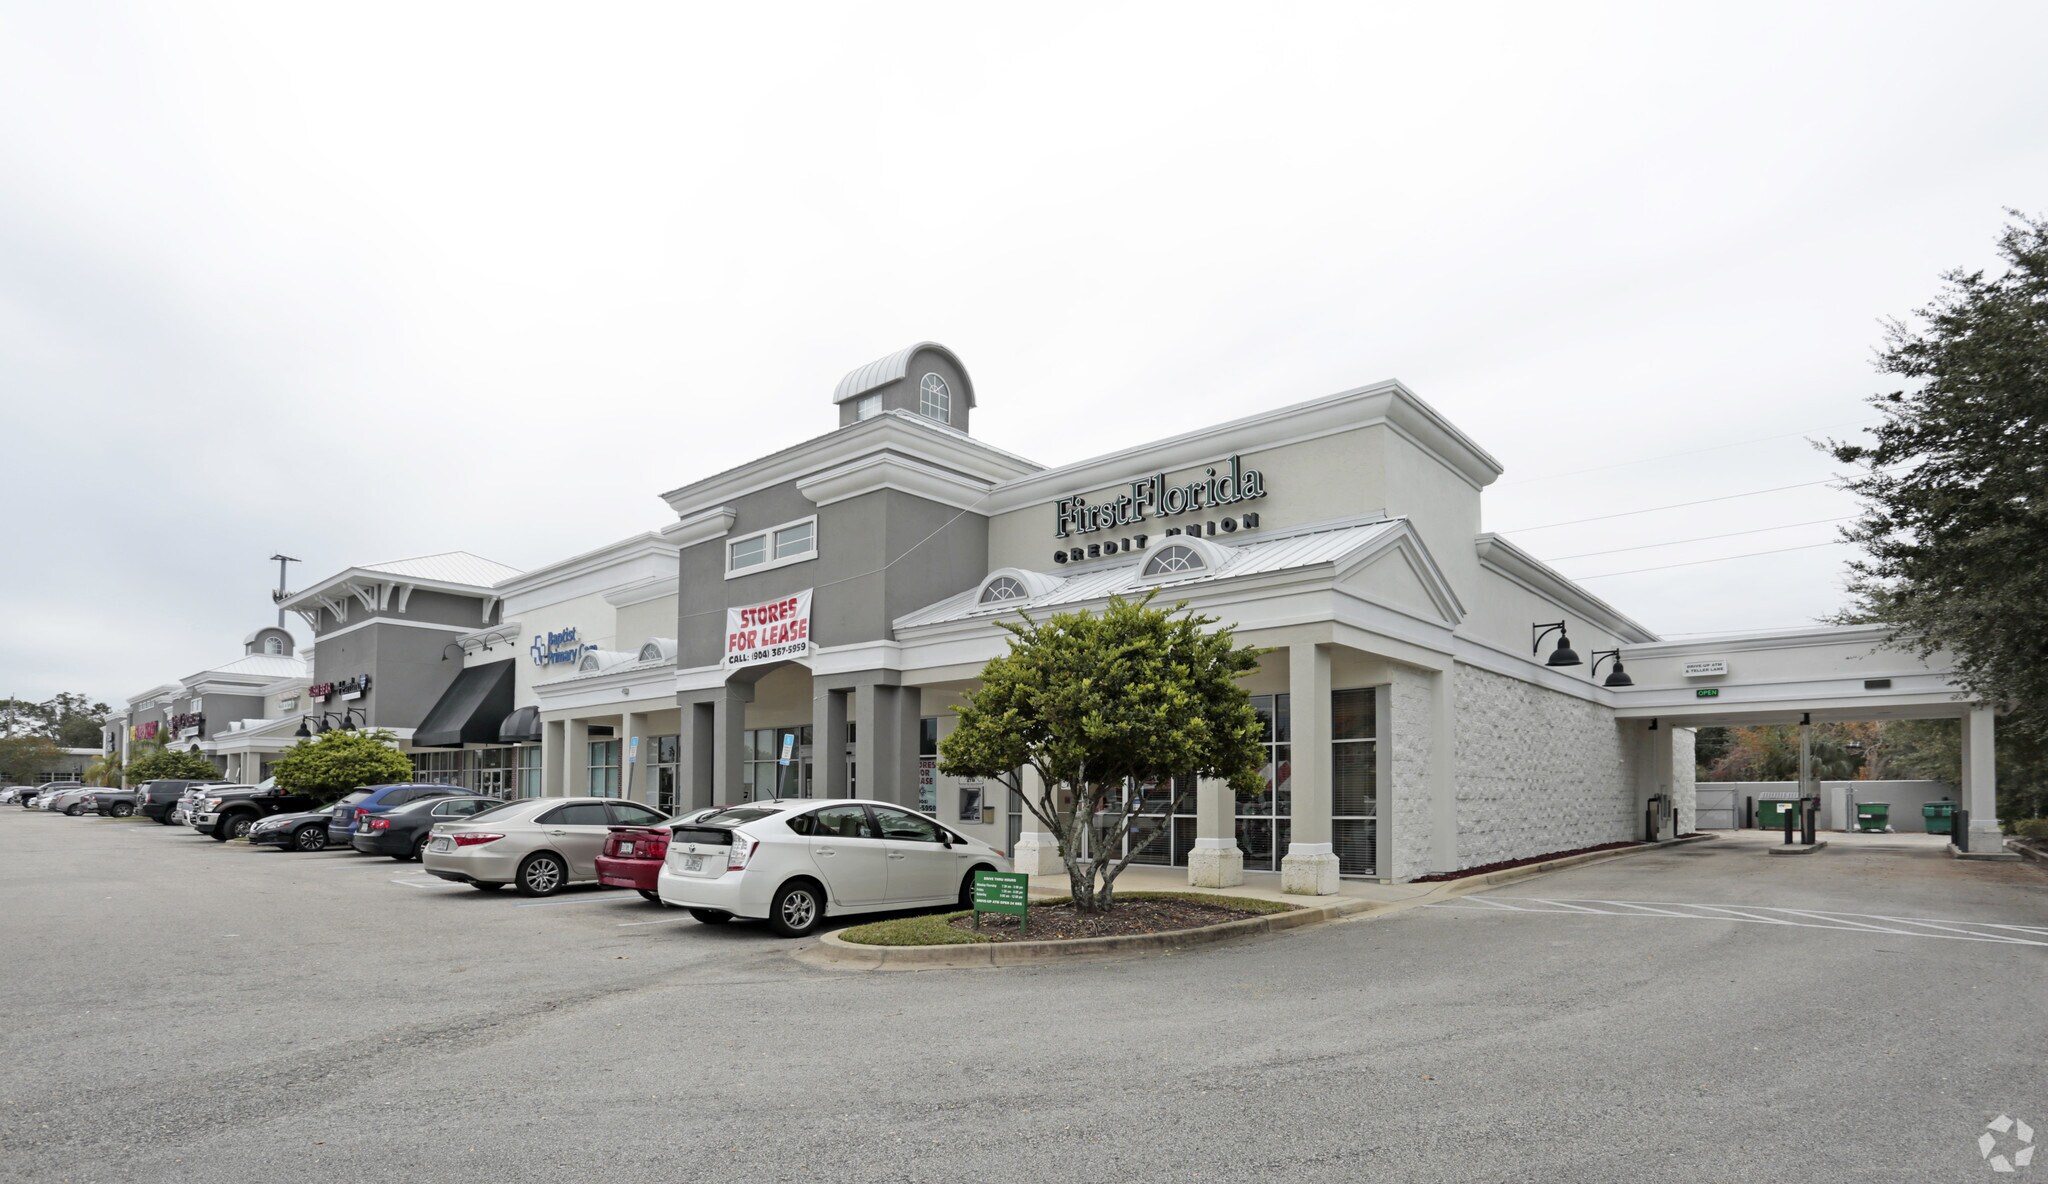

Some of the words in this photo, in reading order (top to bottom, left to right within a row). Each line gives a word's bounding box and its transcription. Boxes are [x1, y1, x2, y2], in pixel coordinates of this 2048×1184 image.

[1054, 534, 1148, 564] CREDIT
[740, 597, 797, 629] STORES
[547, 626, 576, 648] Baptist
[728, 629, 757, 653] FOR
[761, 618, 807, 647] LEASE
[547, 648, 577, 665] Primary
[728, 653, 749, 664] CALL:
[751, 649, 770, 661] (904)
[771, 642, 806, 657] 367-5959
